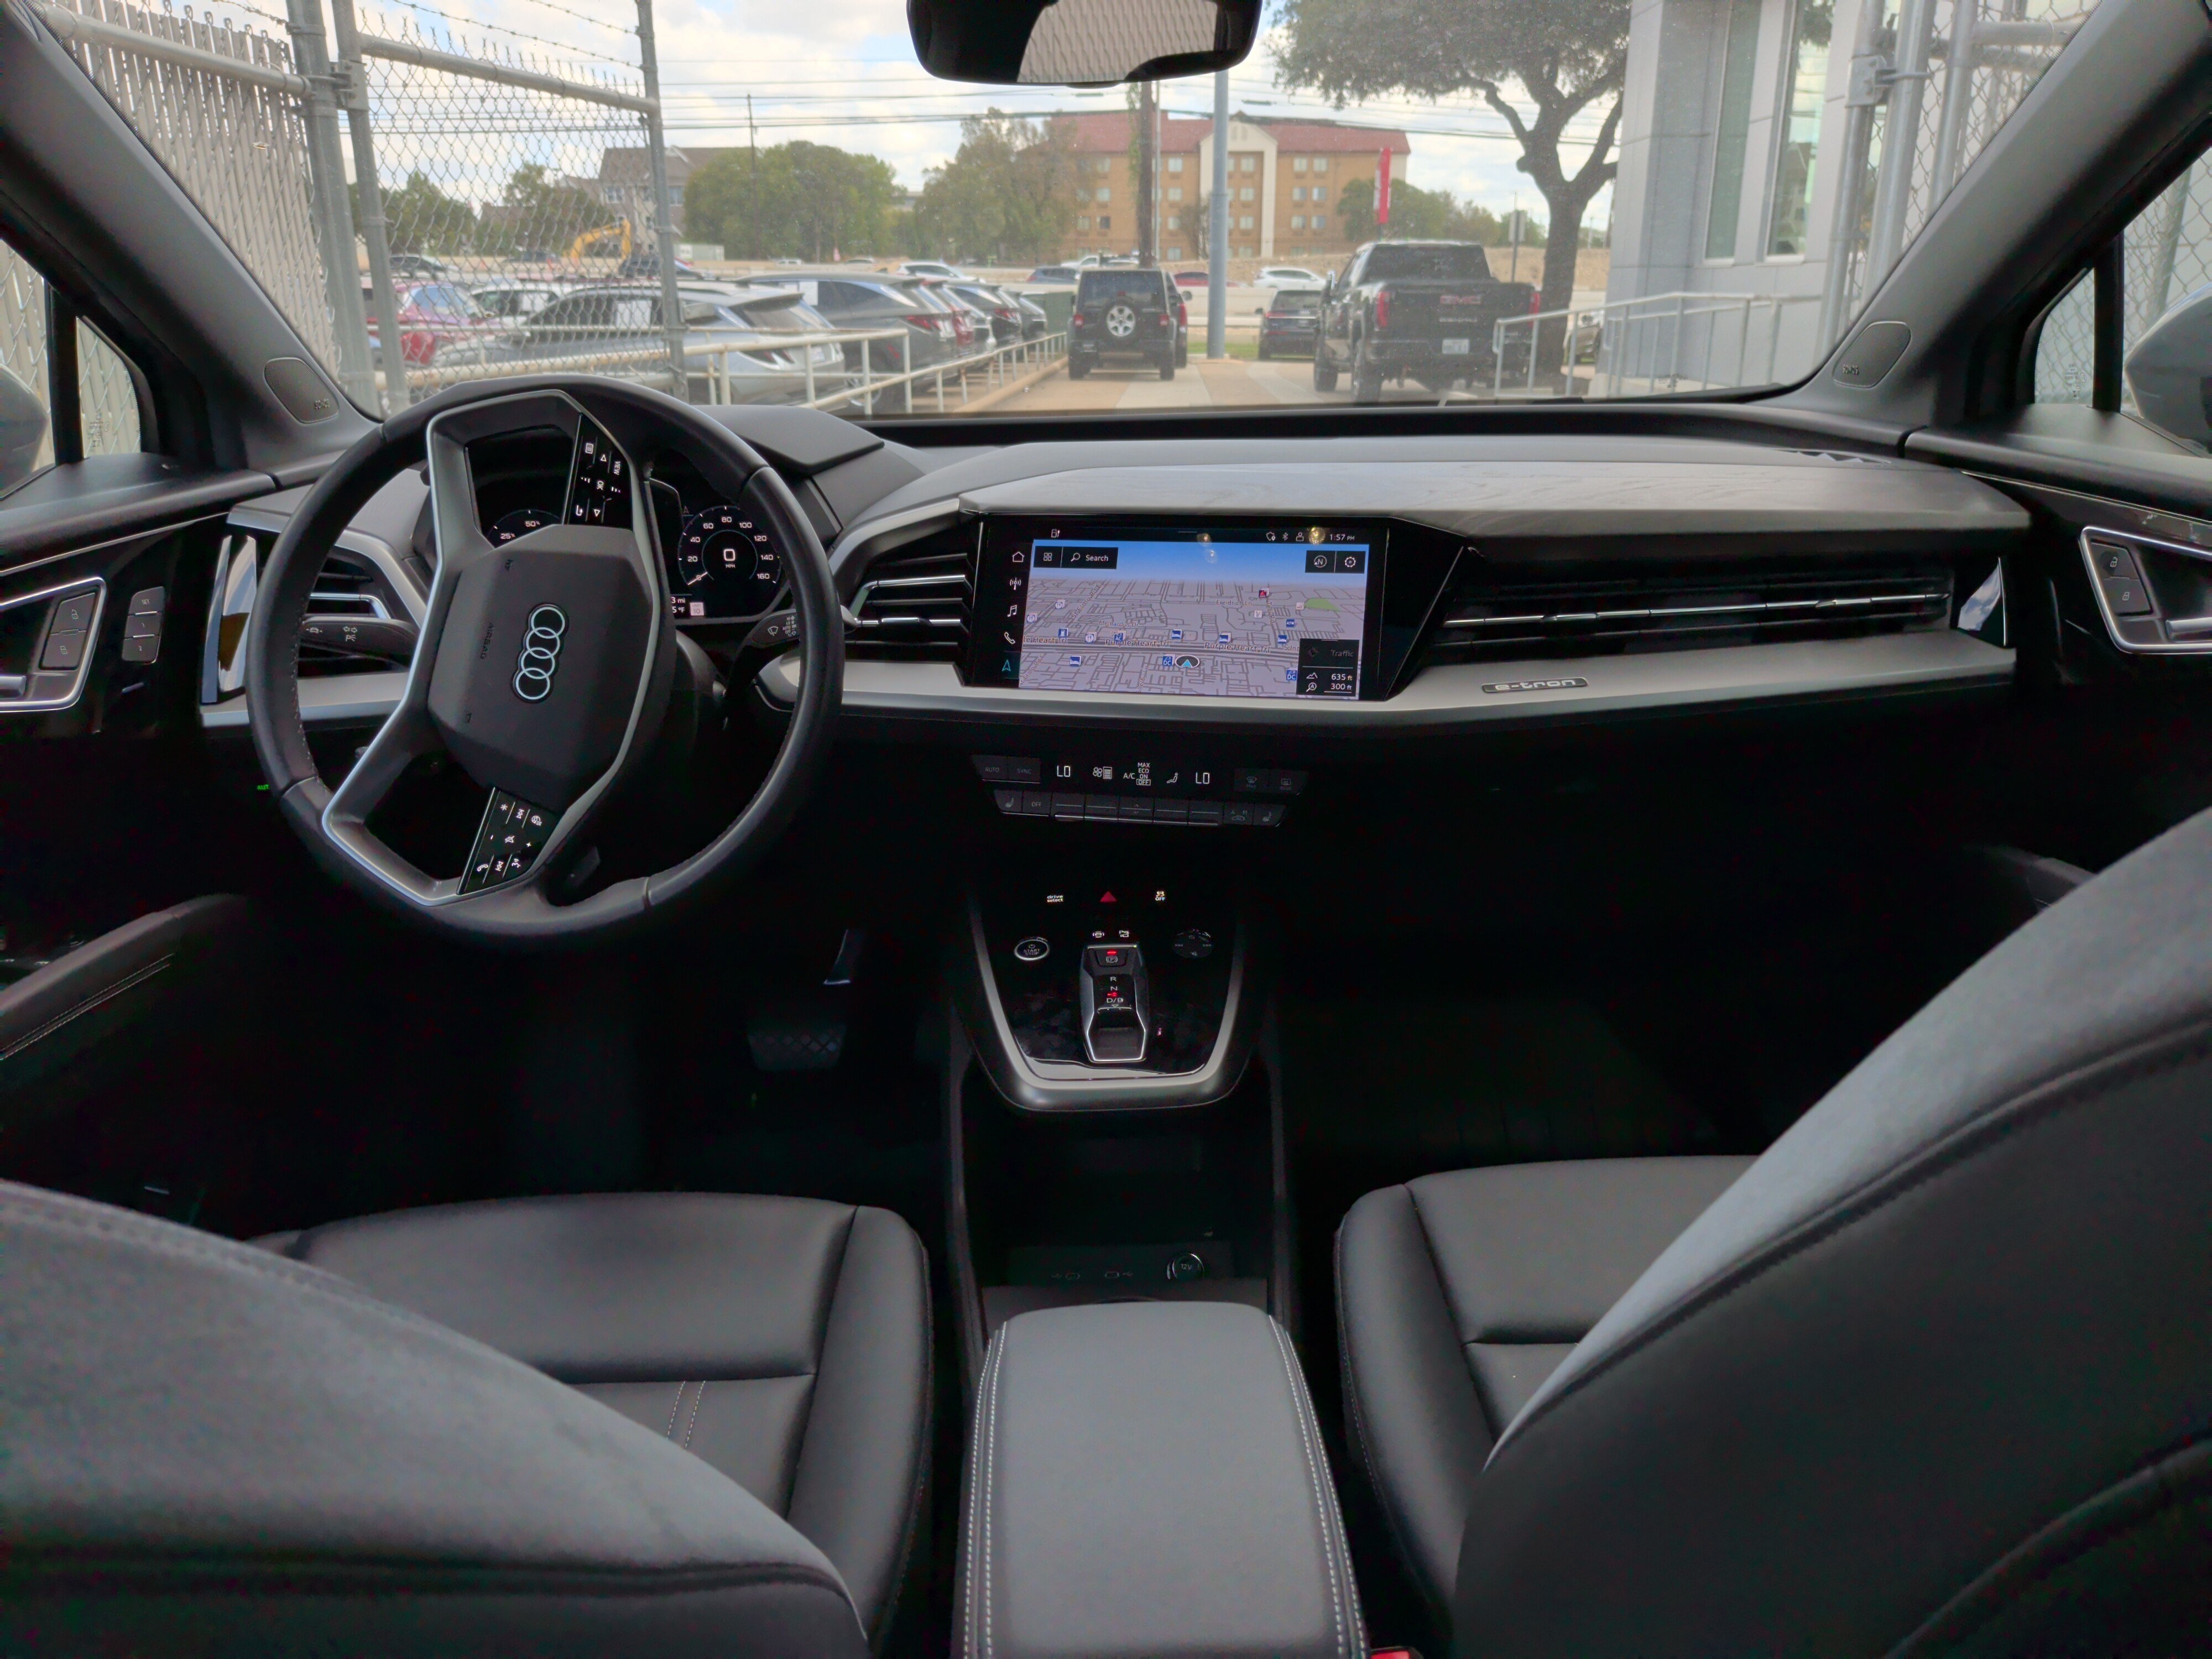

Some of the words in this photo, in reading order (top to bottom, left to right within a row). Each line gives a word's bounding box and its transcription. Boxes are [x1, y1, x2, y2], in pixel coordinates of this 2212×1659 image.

[597, 480, 604, 491] OK
[724, 549, 735, 561] 0
[480, 622, 494, 660] AIRBAG
[1105, 639, 1131, 647] Purple
[1204, 642, 1232, 651] Purple
[1495, 680, 1575, 691] e-tron
[1057, 765, 1071, 777] LO
[1196, 773, 1209, 784] LO
